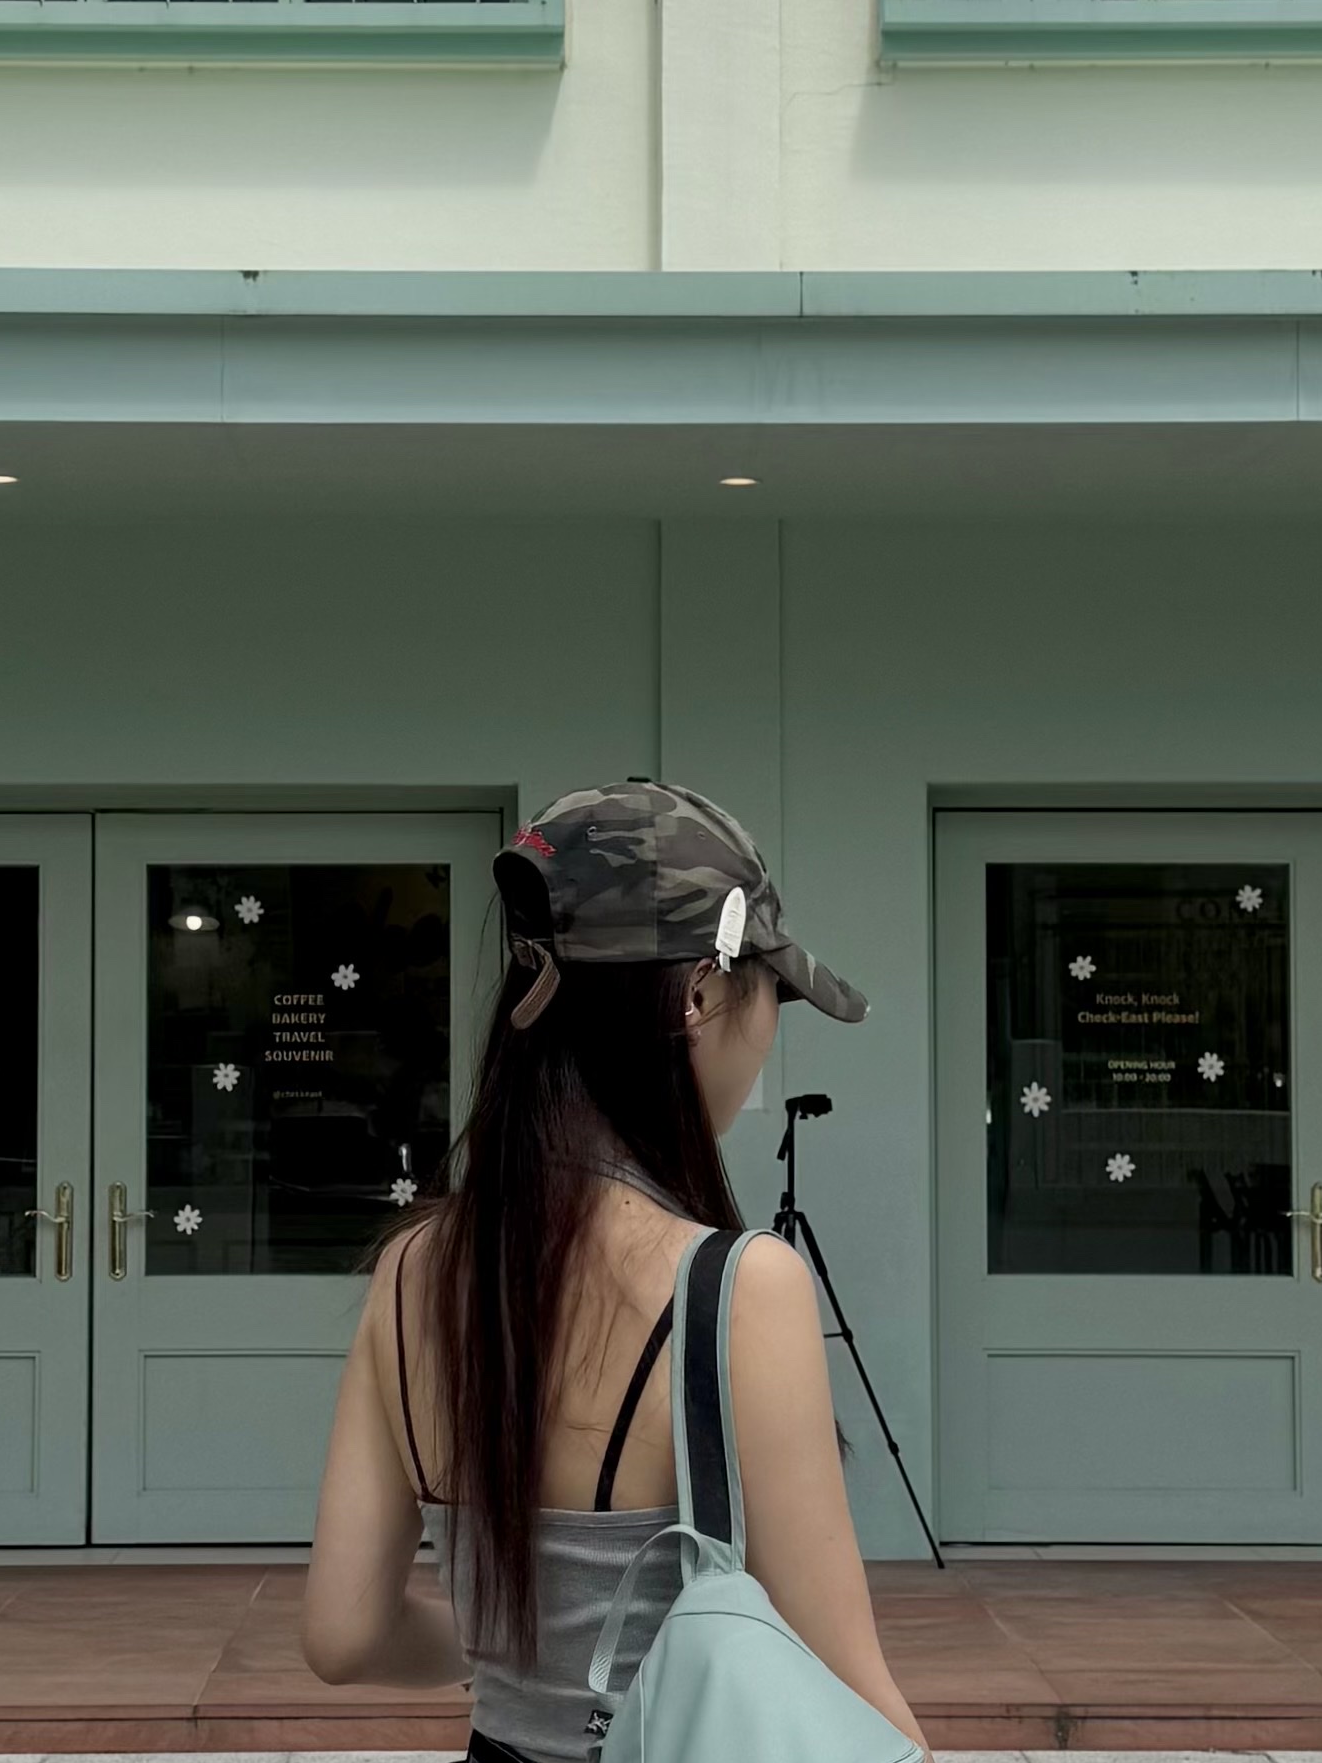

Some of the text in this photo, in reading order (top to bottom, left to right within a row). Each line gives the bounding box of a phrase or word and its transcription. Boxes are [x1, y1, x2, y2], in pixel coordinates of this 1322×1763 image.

[273, 994, 325, 1006] COFFEE
[1141, 992, 1180, 1005] Knock
[271, 1012, 326, 1025] BAKERY
[1152, 1011, 1200, 1024] Please!
[272, 1031, 326, 1043] TRAVEL
[264, 1049, 334, 1062] SOUVENIR
[1149, 1060, 1176, 1070] HOUR
